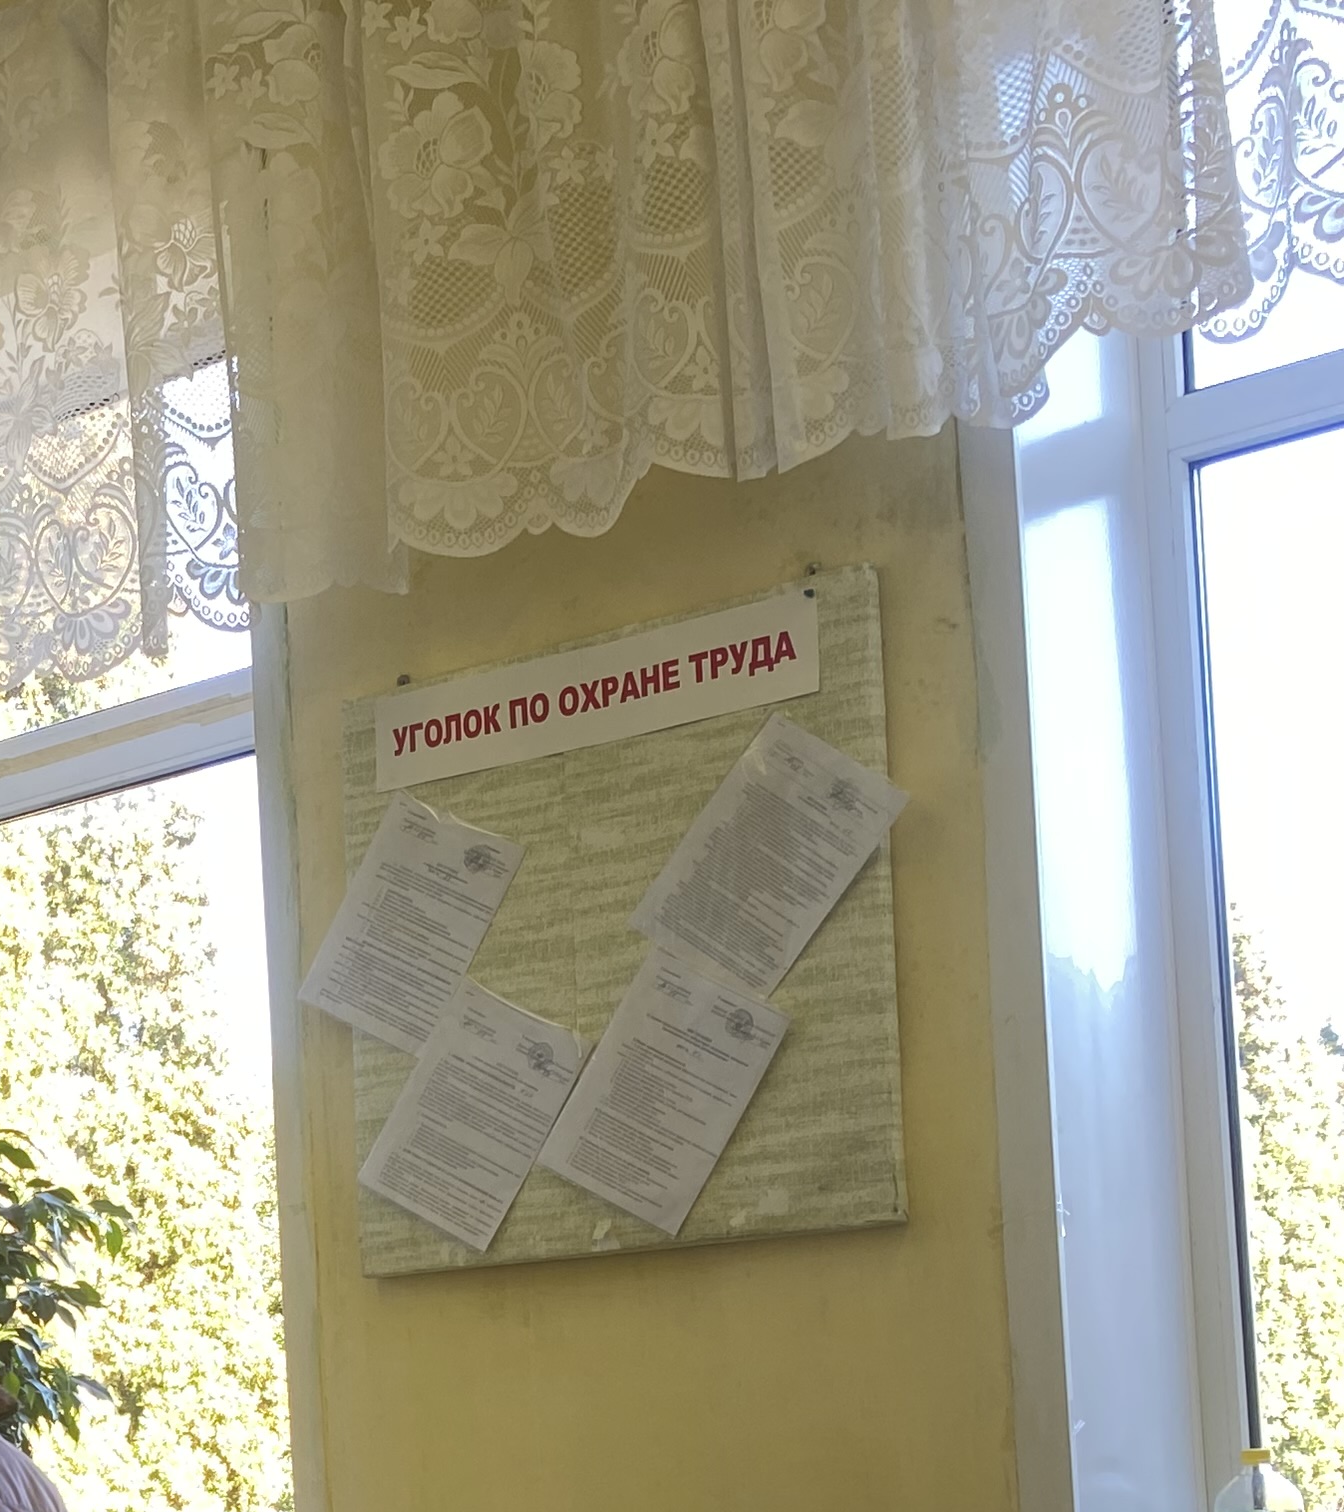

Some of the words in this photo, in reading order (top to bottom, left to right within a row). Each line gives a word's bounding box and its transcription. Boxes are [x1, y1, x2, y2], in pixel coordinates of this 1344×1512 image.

[392, 703, 501, 757] УГОЛОК
[508, 692, 550, 729] ПО
[558, 659, 681, 717] ОХРАНЕ
[688, 631, 797, 684] ТРУДА
